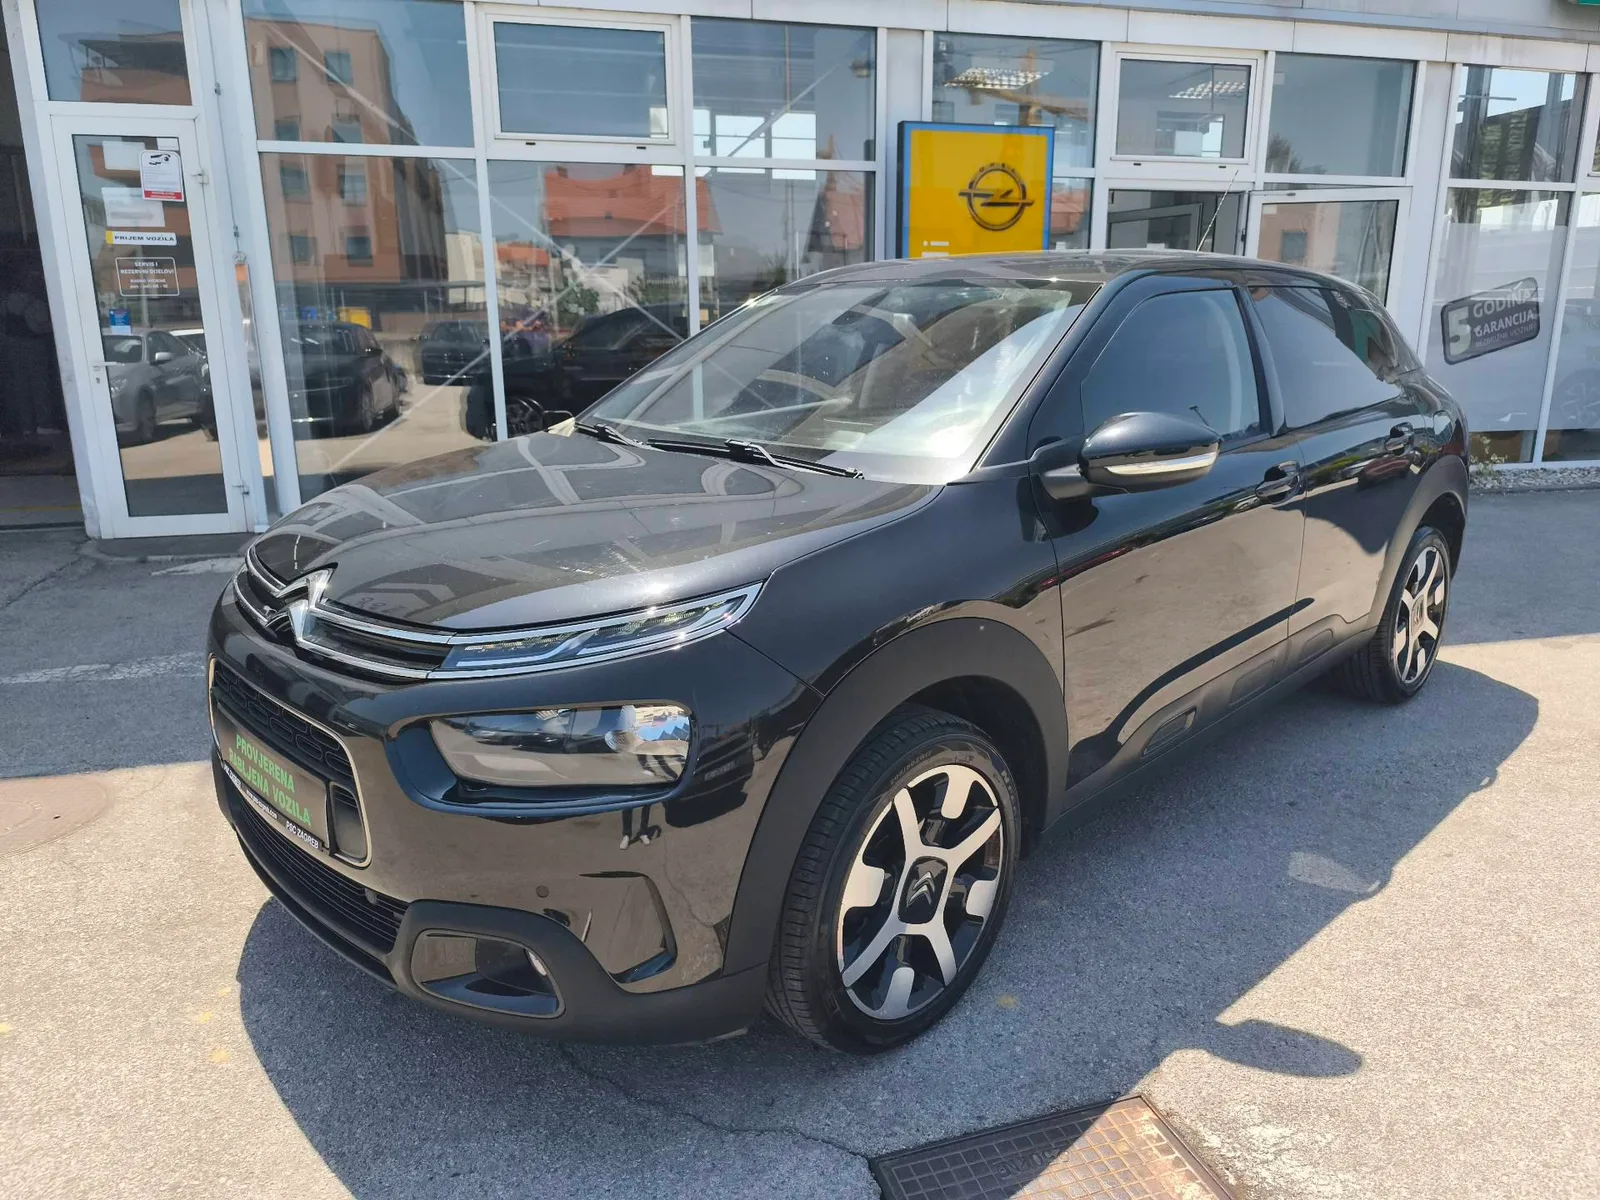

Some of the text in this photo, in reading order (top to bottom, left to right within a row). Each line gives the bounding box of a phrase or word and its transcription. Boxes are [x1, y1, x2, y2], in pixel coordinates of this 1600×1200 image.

[1448, 288, 1532, 356] 5 GODINA
[1474, 308, 1536, 338] GARANCIJA
[228, 747, 270, 797] RABLJENA
[272, 785, 312, 826] VOZILA
[236, 733, 295, 793] PROVJERENA
[285, 820, 319, 850] PSC ZAGREB
